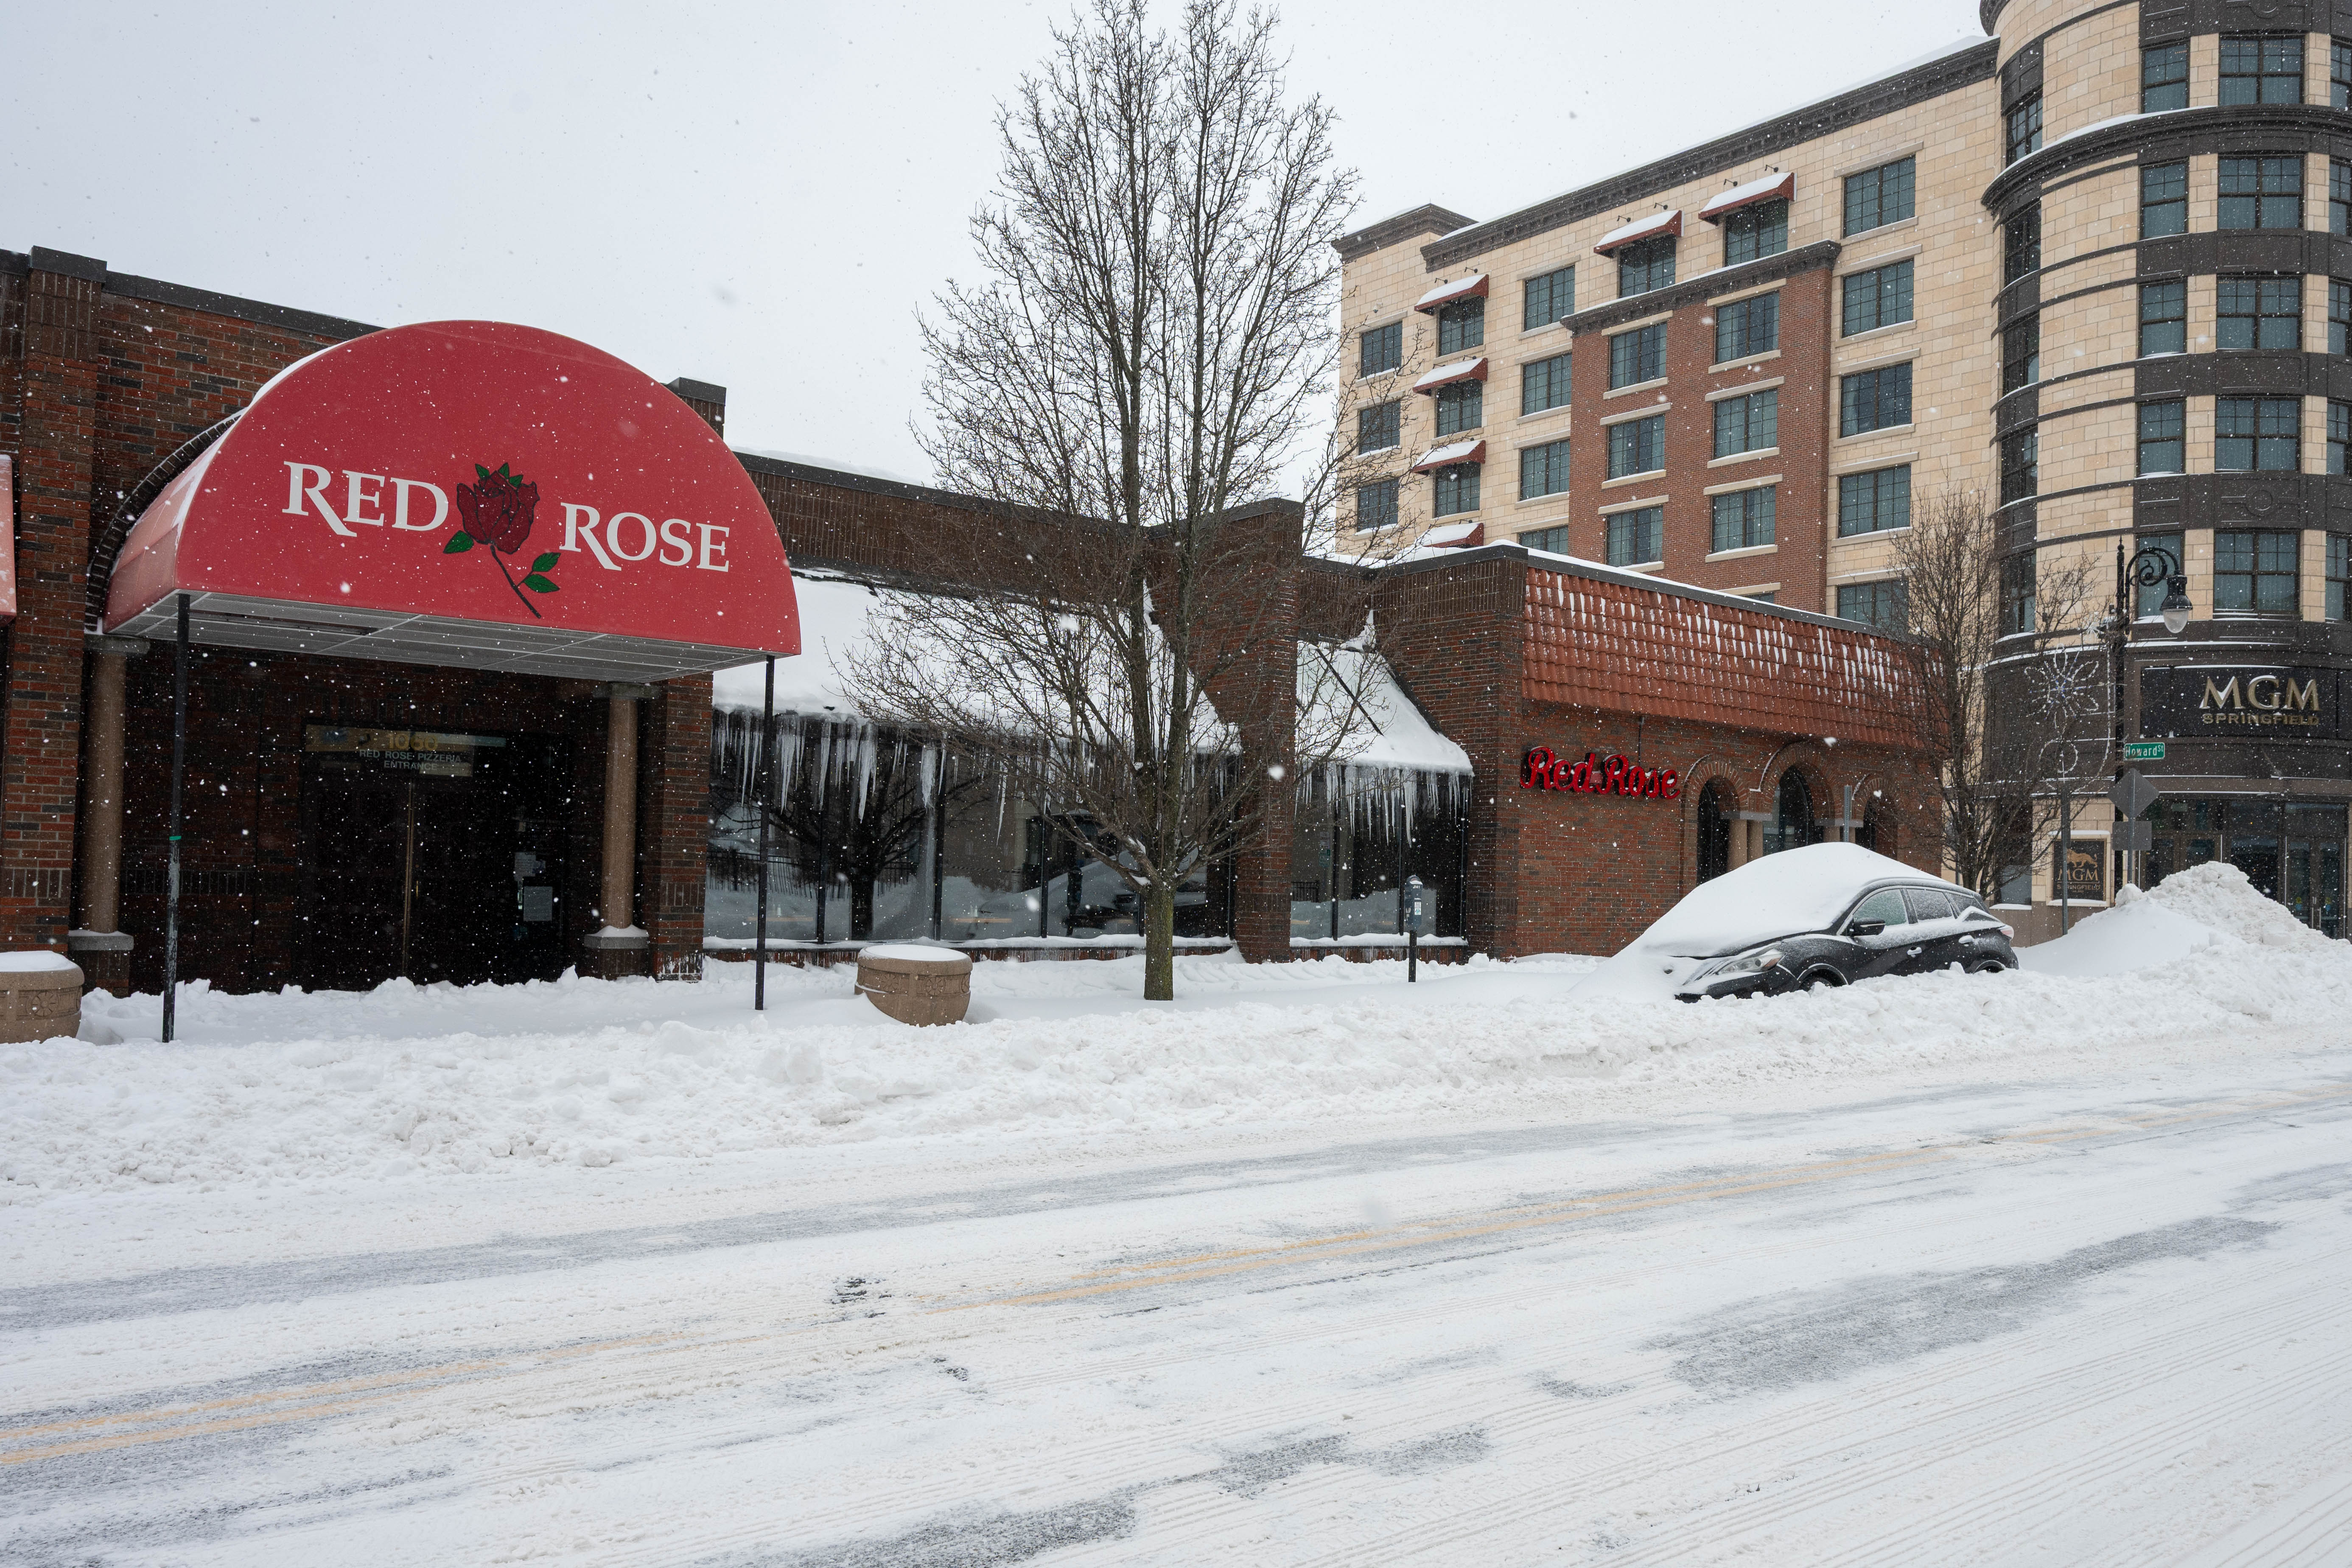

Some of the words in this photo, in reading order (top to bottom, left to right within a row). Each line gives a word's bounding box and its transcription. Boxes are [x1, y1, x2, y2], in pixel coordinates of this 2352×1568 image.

[282, 461, 448, 537] RED
[560, 502, 730, 572] ROSE
[2199, 675, 2322, 711] MGM
[2202, 713, 2319, 725] SPRINGFIELD
[387, 733, 438, 750] 1060
[359, 749, 380, 758] RED
[385, 751, 413, 760] ROSE
[418, 753, 461, 763] PIZZERIA
[2125, 746, 2157, 756] Howard
[384, 761, 437, 770] ENTRANCE
[1520, 746, 1596, 793] Red
[1596, 754, 1680, 799] Rose
